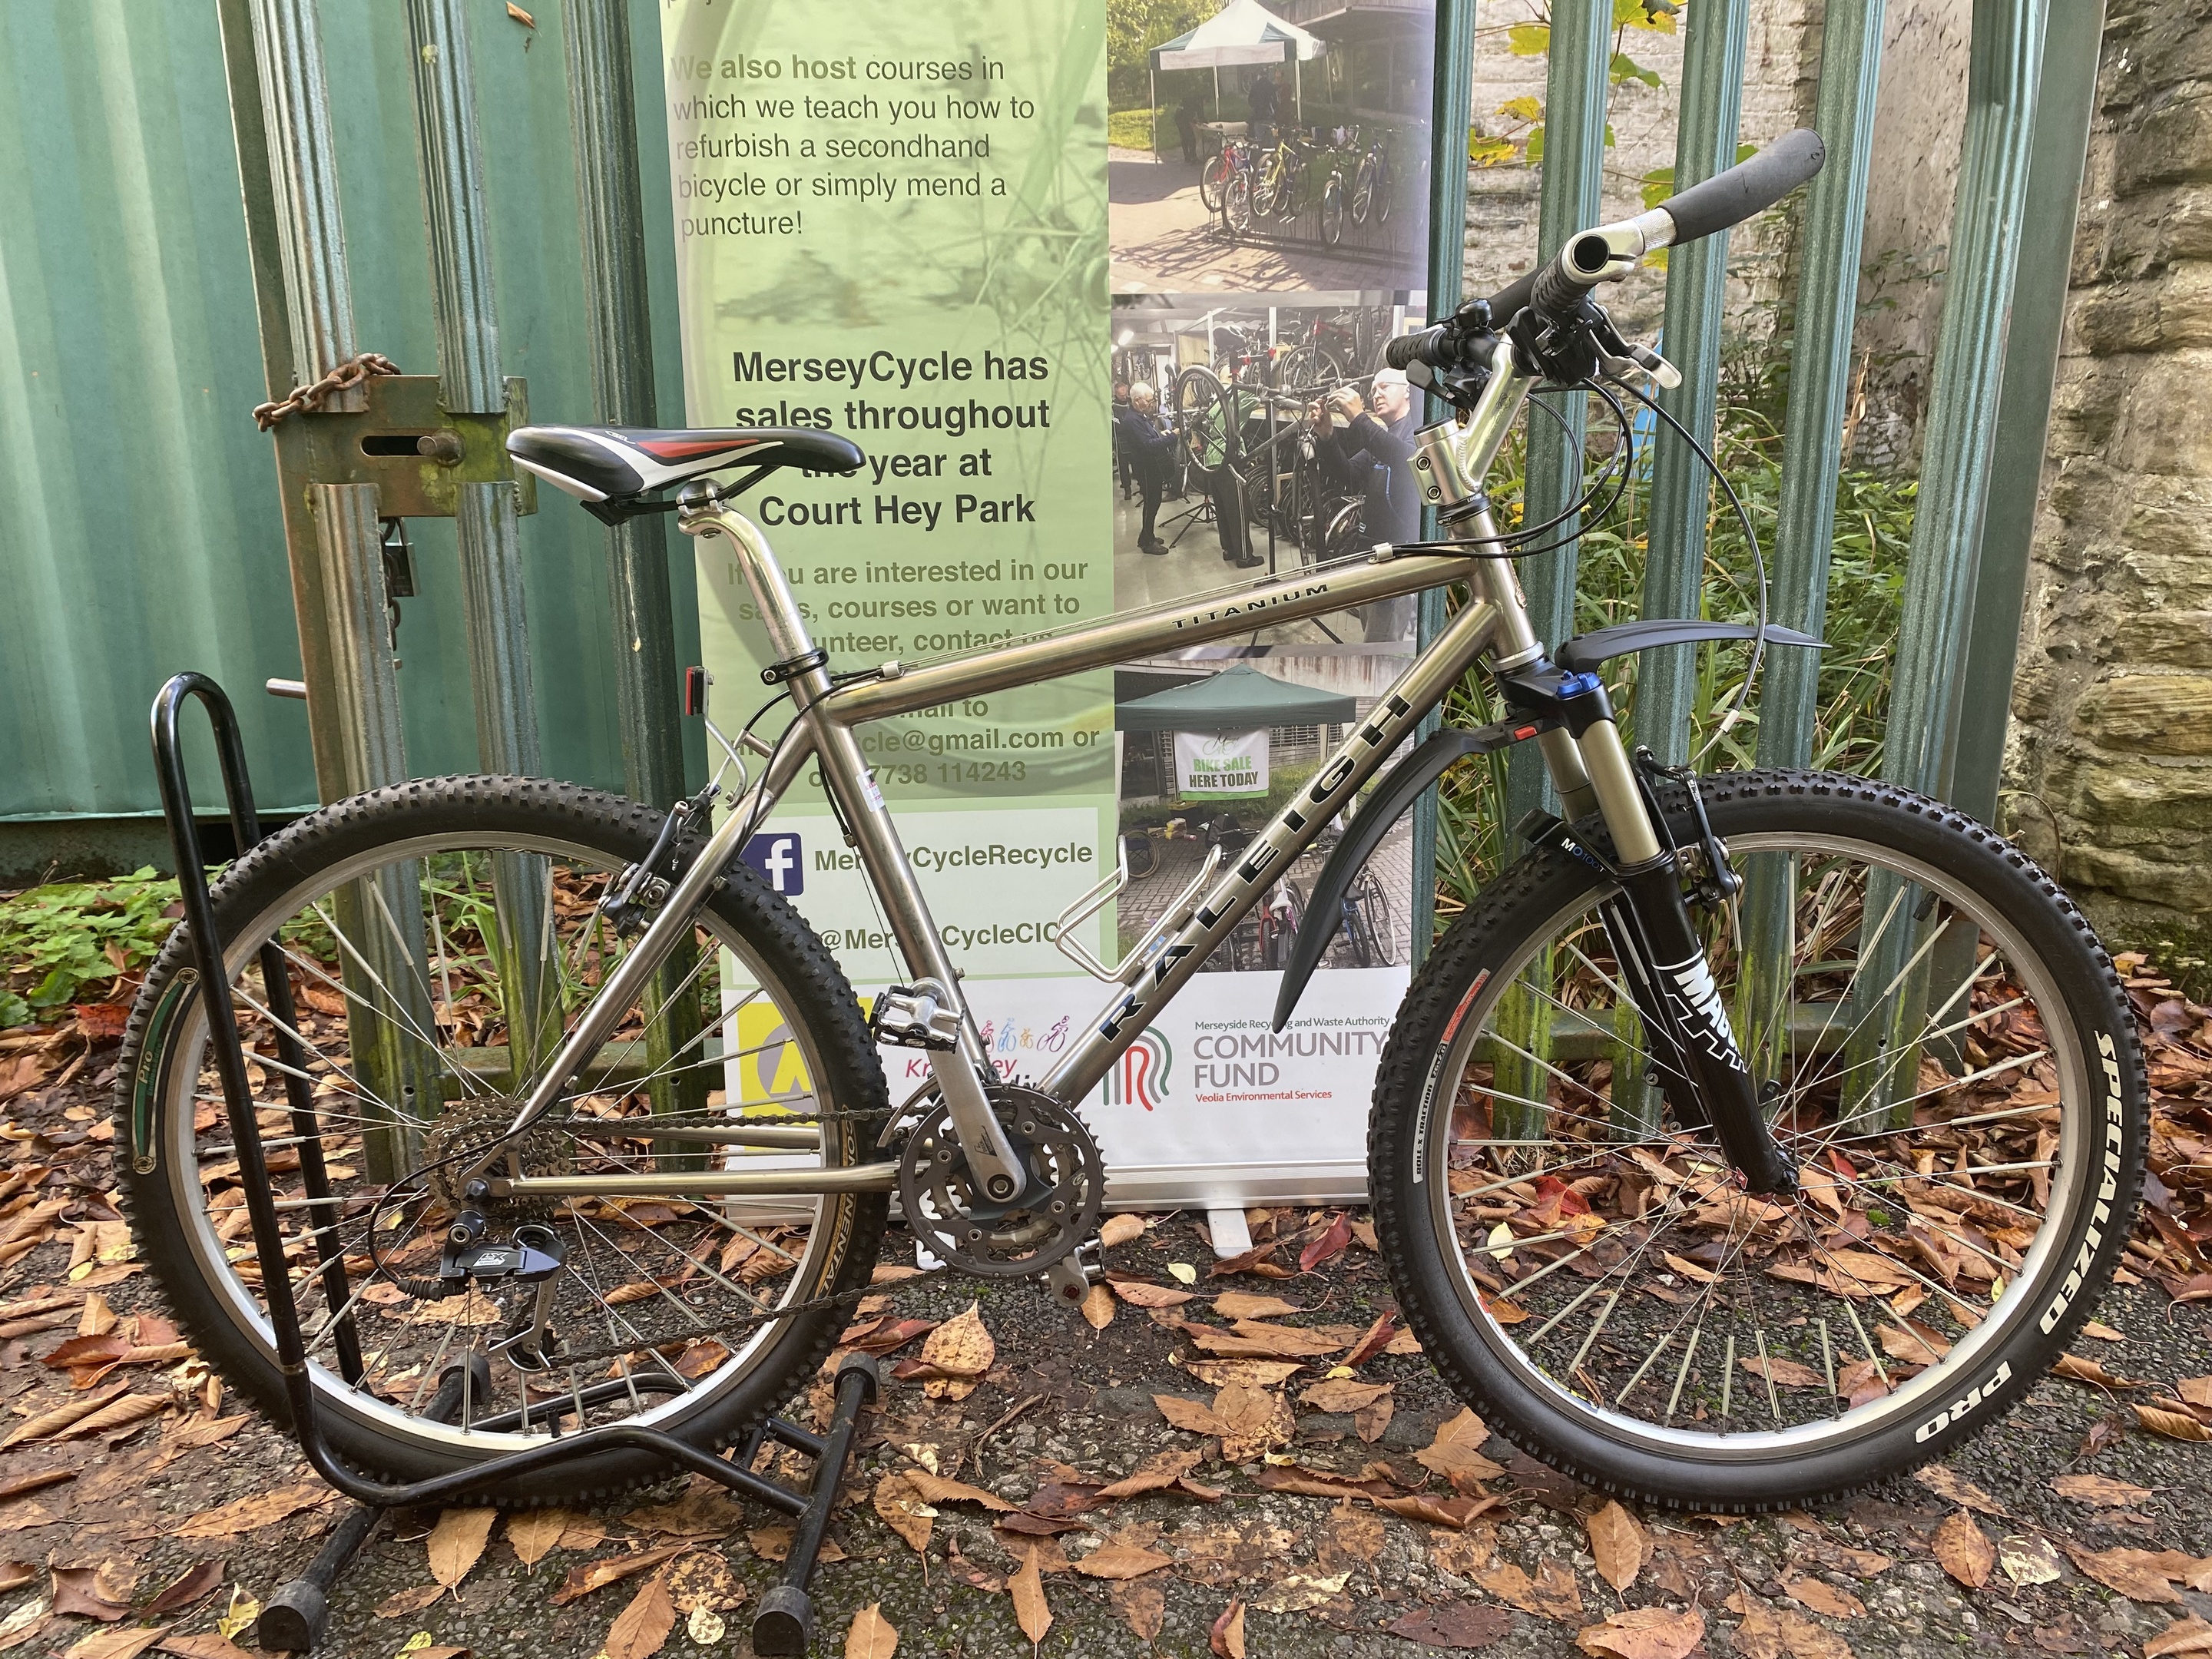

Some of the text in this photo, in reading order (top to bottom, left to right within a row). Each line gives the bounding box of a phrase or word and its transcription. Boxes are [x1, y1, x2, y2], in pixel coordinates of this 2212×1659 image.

[671, 55, 1004, 81] We also host courses in
[674, 94, 1035, 125] which we teach you how to
[677, 134, 989, 160] refurbish a secondhand
[679, 173, 1007, 203] bicycle or simply mend a
[680, 211, 802, 242] puncture!
[733, 350, 1048, 389] MerseyCycle has
[736, 399, 1050, 437] sales throughout
[868, 449, 992, 485] year at
[759, 494, 1035, 531] Court Hey Park
[813, 563, 857, 584] are
[866, 560, 1000, 583] interested
[1011, 559, 1035, 581] in
[1043, 561, 1088, 580] our
[828, 598, 936, 619] courses
[946, 597, 973, 615] or
[982, 594, 1046, 615] want
[1054, 594, 1080, 614] to
[1172, 584, 1330, 629] TITANIUM
[769, 632, 904, 655] unteer,
[913, 629, 1013, 651] contact
[962, 700, 988, 717] to
[1073, 728, 1100, 747] or
[869, 763, 928, 785] 7738
[937, 760, 1026, 783] 114243
[1193, 756, 1252, 772] BIKE SALE
[1189, 771, 1258, 787] HERE TODAY
[815, 843, 1092, 872] MerCycleRecycle
[1098, 694, 1412, 1043] RALEIGH
[823, 922, 1058, 952] @MerCycleCIC
[1195, 1016, 1390, 1031] Merseyside Recyg and Waste Authority
[1194, 1031, 1389, 1060] COMMUNITY
[1194, 1062, 1280, 1088] FUND
[1195, 1090, 1332, 1103] Veolia Environmental Services
[2039, 1030, 2122, 1336] SPECIALIZED
[1915, 1360, 2012, 1444] PRO
